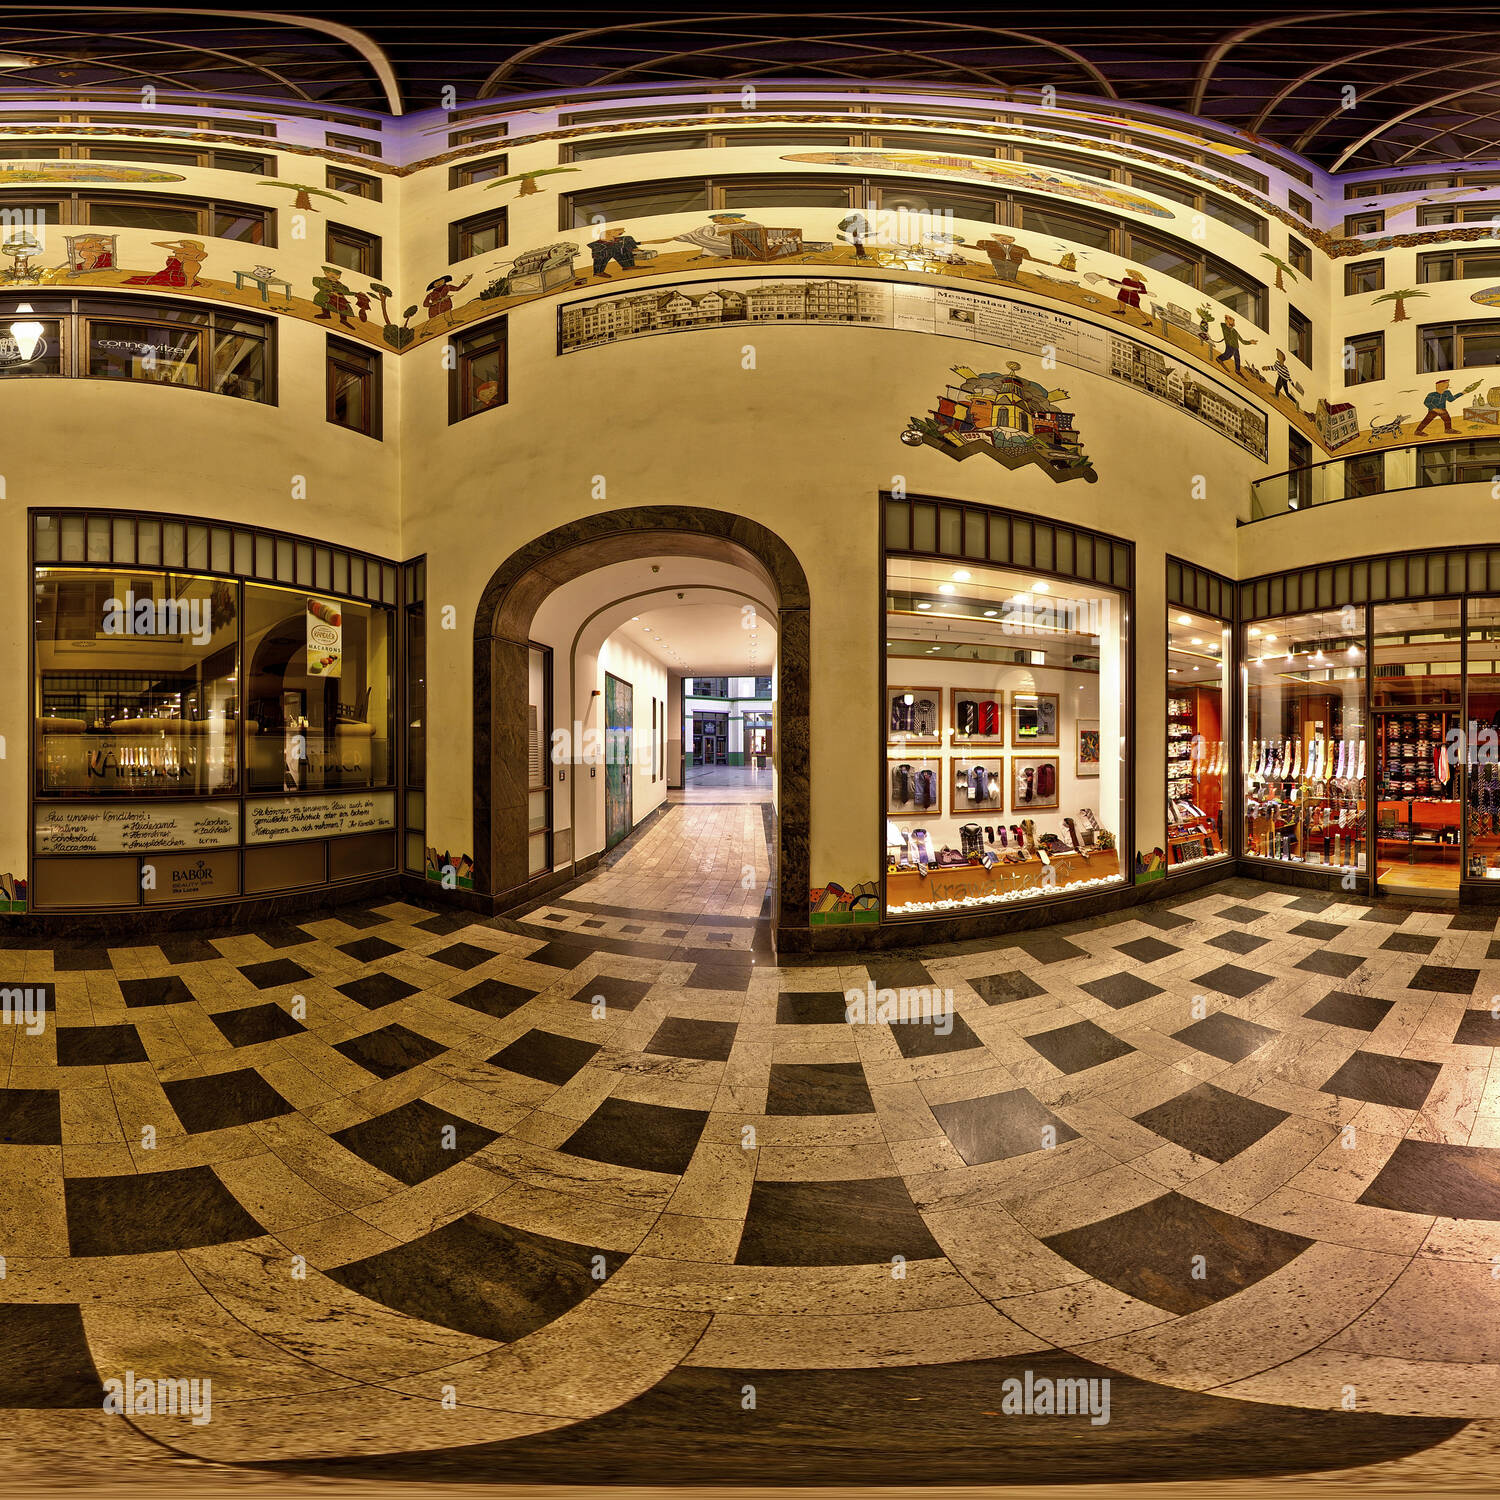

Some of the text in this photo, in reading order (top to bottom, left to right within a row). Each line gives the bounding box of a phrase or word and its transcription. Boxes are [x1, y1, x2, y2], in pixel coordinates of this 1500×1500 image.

[937, 291, 1073, 327] Messepalast Specks Hof
[308, 644, 341, 653] MACARONS
[172, 868, 213, 882] BABOR
